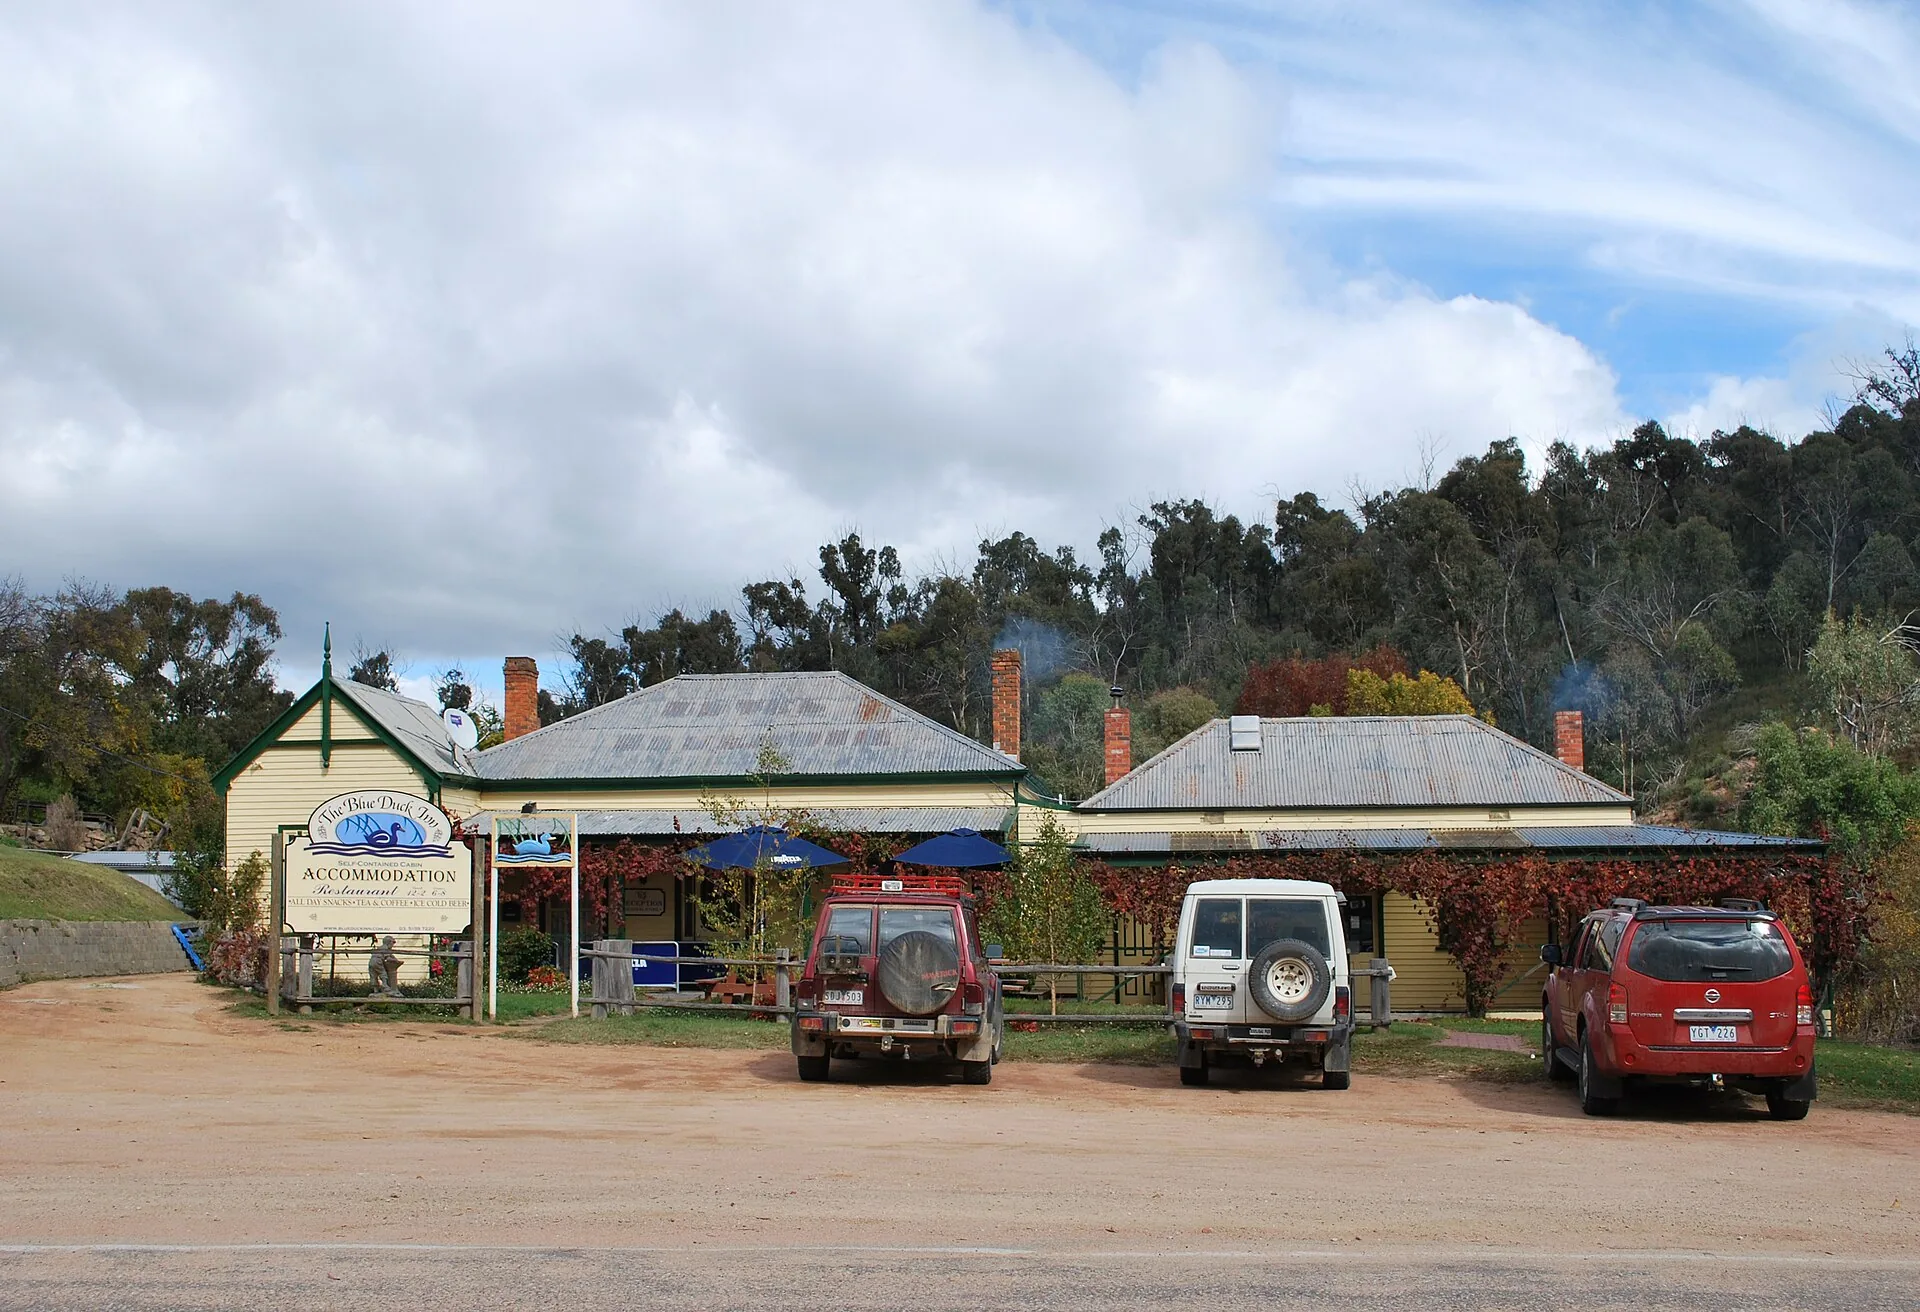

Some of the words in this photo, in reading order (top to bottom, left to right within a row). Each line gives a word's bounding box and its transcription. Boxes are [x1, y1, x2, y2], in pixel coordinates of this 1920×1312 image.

[318, 807, 343, 824] The
[343, 796, 376, 812] Blue
[377, 795, 414, 819] Duck
[417, 806, 439, 828] Inn
[302, 868, 456, 883] ACCOMMODATION
[312, 884, 399, 896] Restaurant
[380, 899, 409, 907] COFFEE
[824, 991, 841, 1001] SDJ
[846, 991, 862, 1001] 503
[1195, 995, 1211, 1005] RYM
[1216, 996, 1232, 1006] 295
[1691, 1027, 1709, 1038] YGT
[1717, 1027, 1735, 1038] 226
